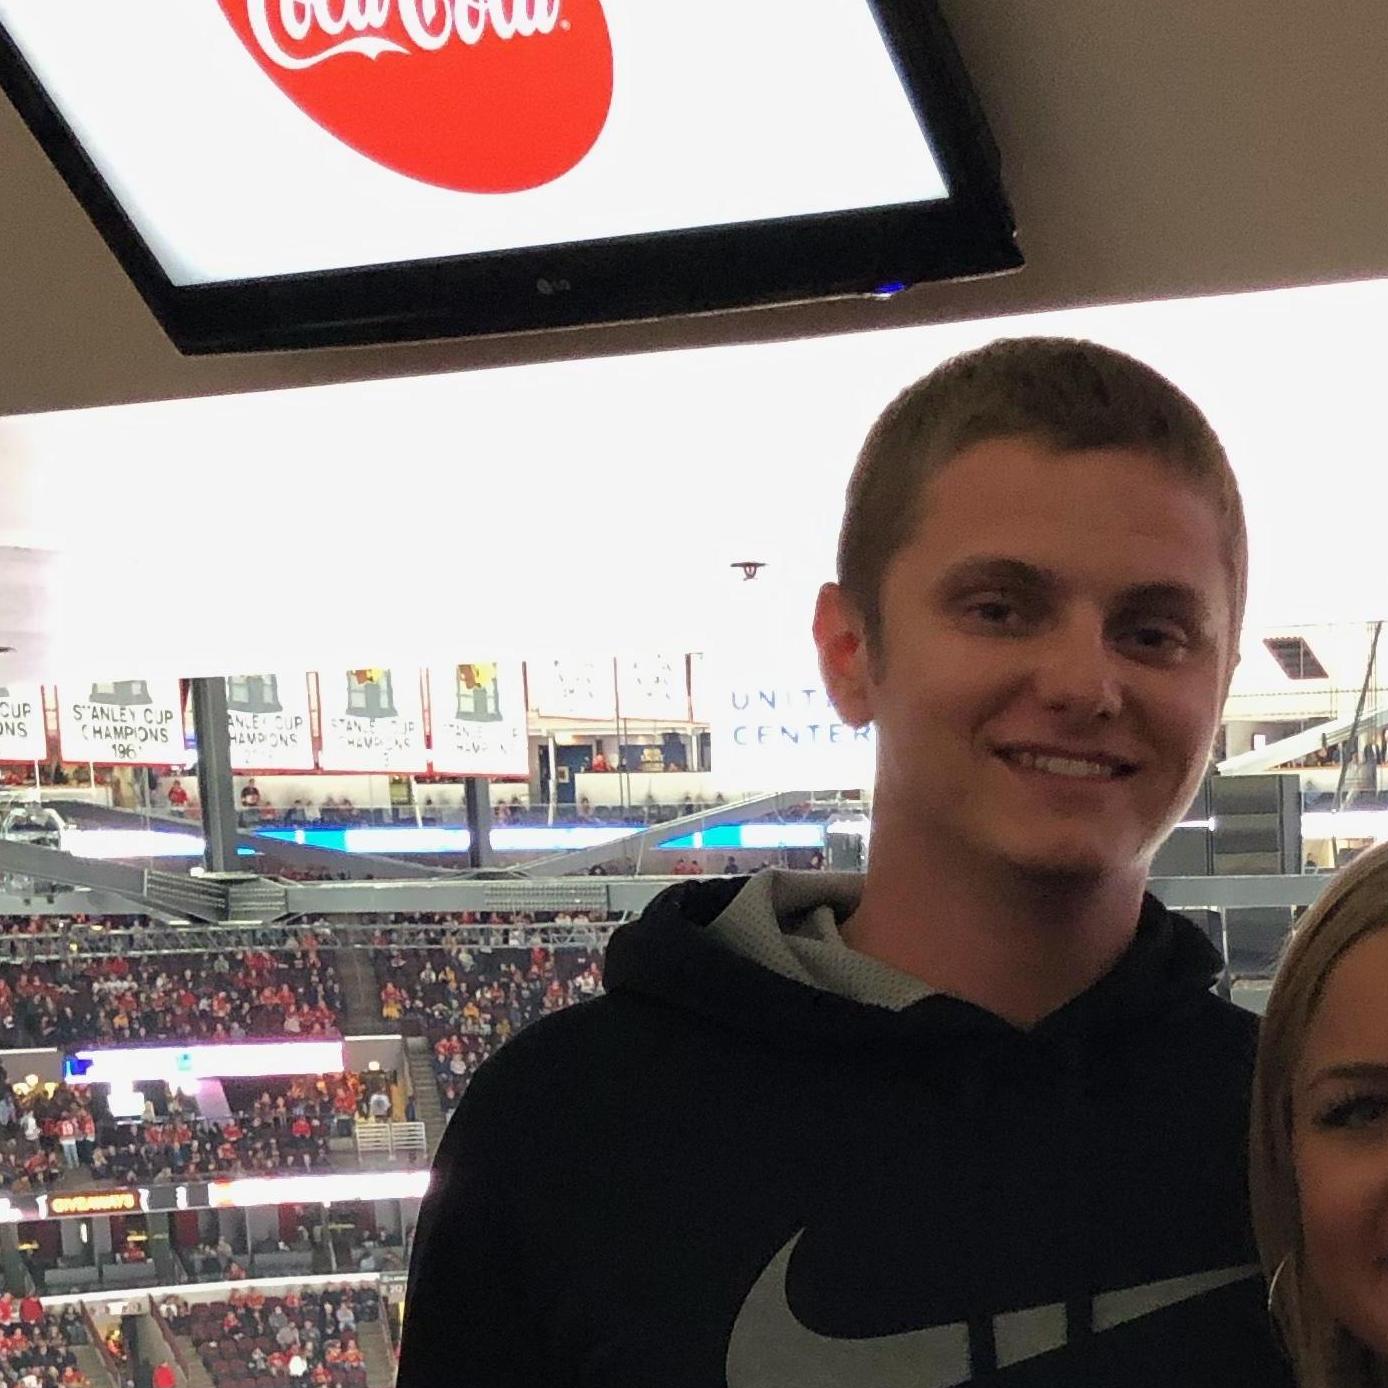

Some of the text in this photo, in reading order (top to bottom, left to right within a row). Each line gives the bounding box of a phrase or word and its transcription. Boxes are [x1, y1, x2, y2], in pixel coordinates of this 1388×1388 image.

[246, 0, 561, 69] CocaCola
[731, 689, 836, 710] UNIT
[81, 724, 169, 743] CHAMPIONS
[111, 744, 142, 759] 196
